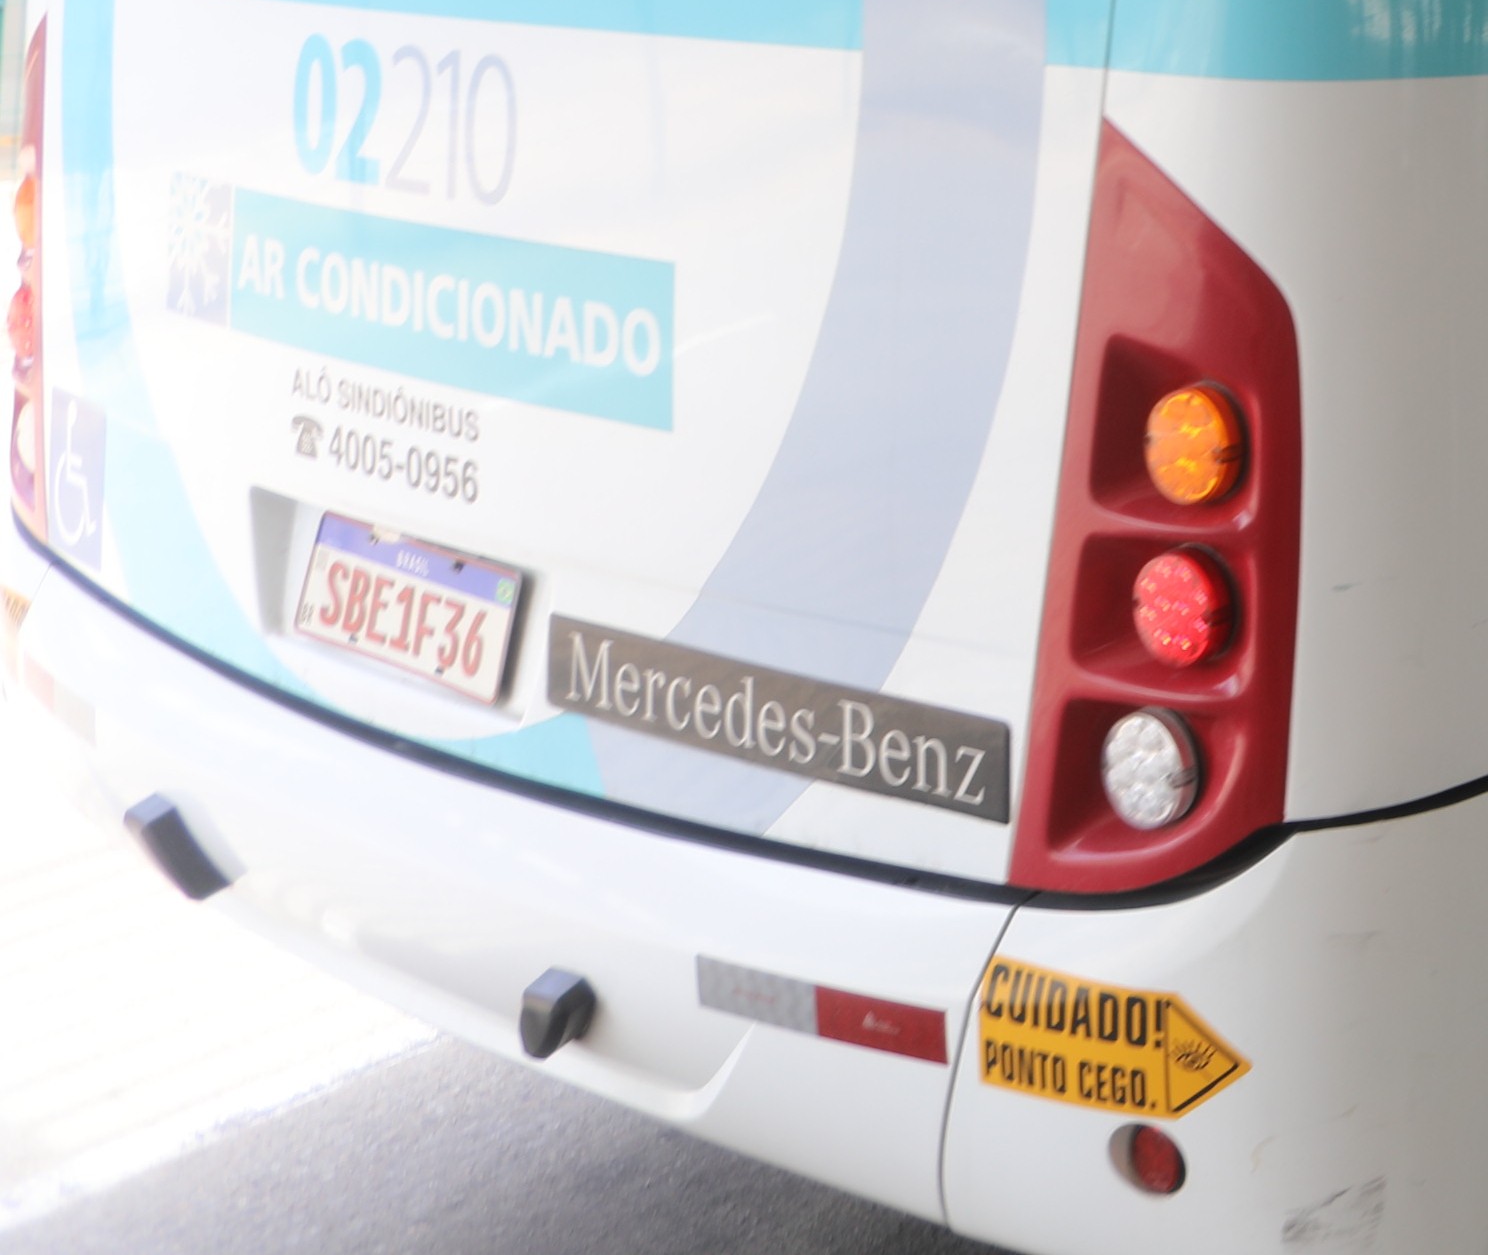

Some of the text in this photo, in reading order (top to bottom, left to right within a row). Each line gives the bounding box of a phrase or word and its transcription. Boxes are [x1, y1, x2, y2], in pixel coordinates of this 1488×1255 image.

[293, 32, 518, 207] 02210
[237, 234, 662, 377] AR CONDICIONADO
[328, 425, 478, 504] 4005-0956
[318, 559, 488, 678] SBE1F36
[564, 630, 988, 807] Mercedes-Benz
[985, 963, 1165, 1048] CUIDADO!
[984, 1039, 1158, 1111] PONTO CEGO.
